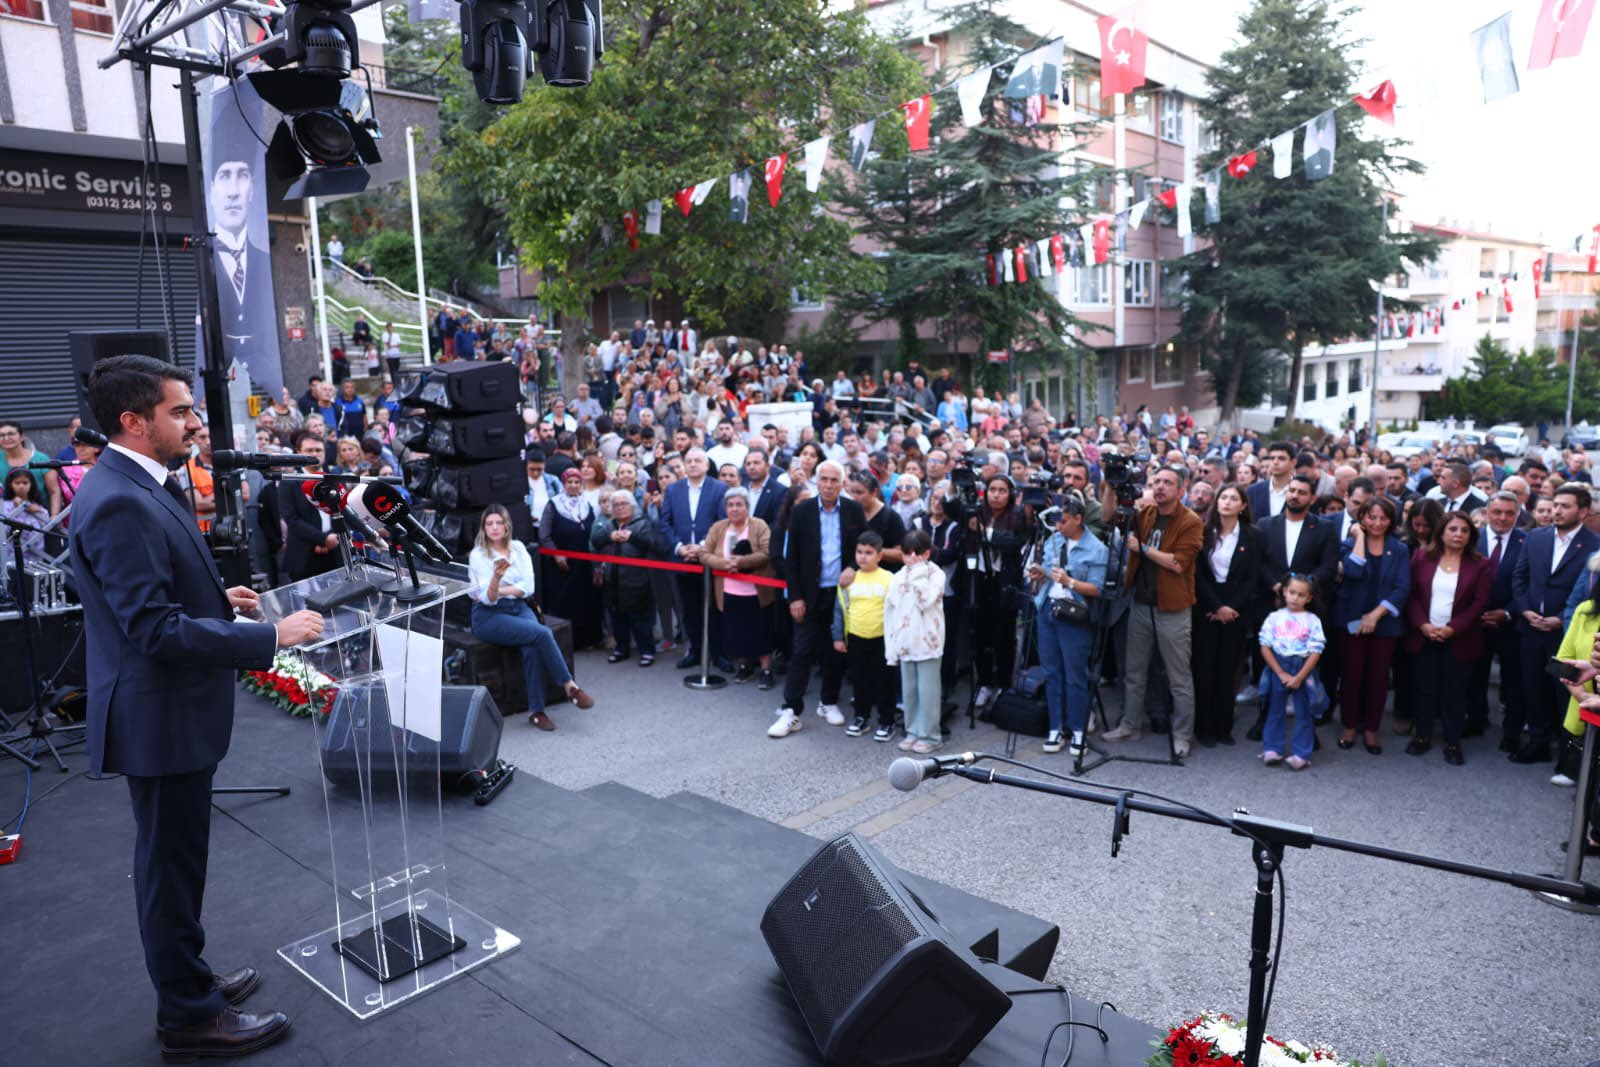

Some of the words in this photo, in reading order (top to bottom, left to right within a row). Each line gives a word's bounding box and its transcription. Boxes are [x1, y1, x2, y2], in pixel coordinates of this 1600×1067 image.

[75, 171, 172, 198] Service
[86, 196, 119, 209] (0312)
[121, 199, 141, 209] 234
